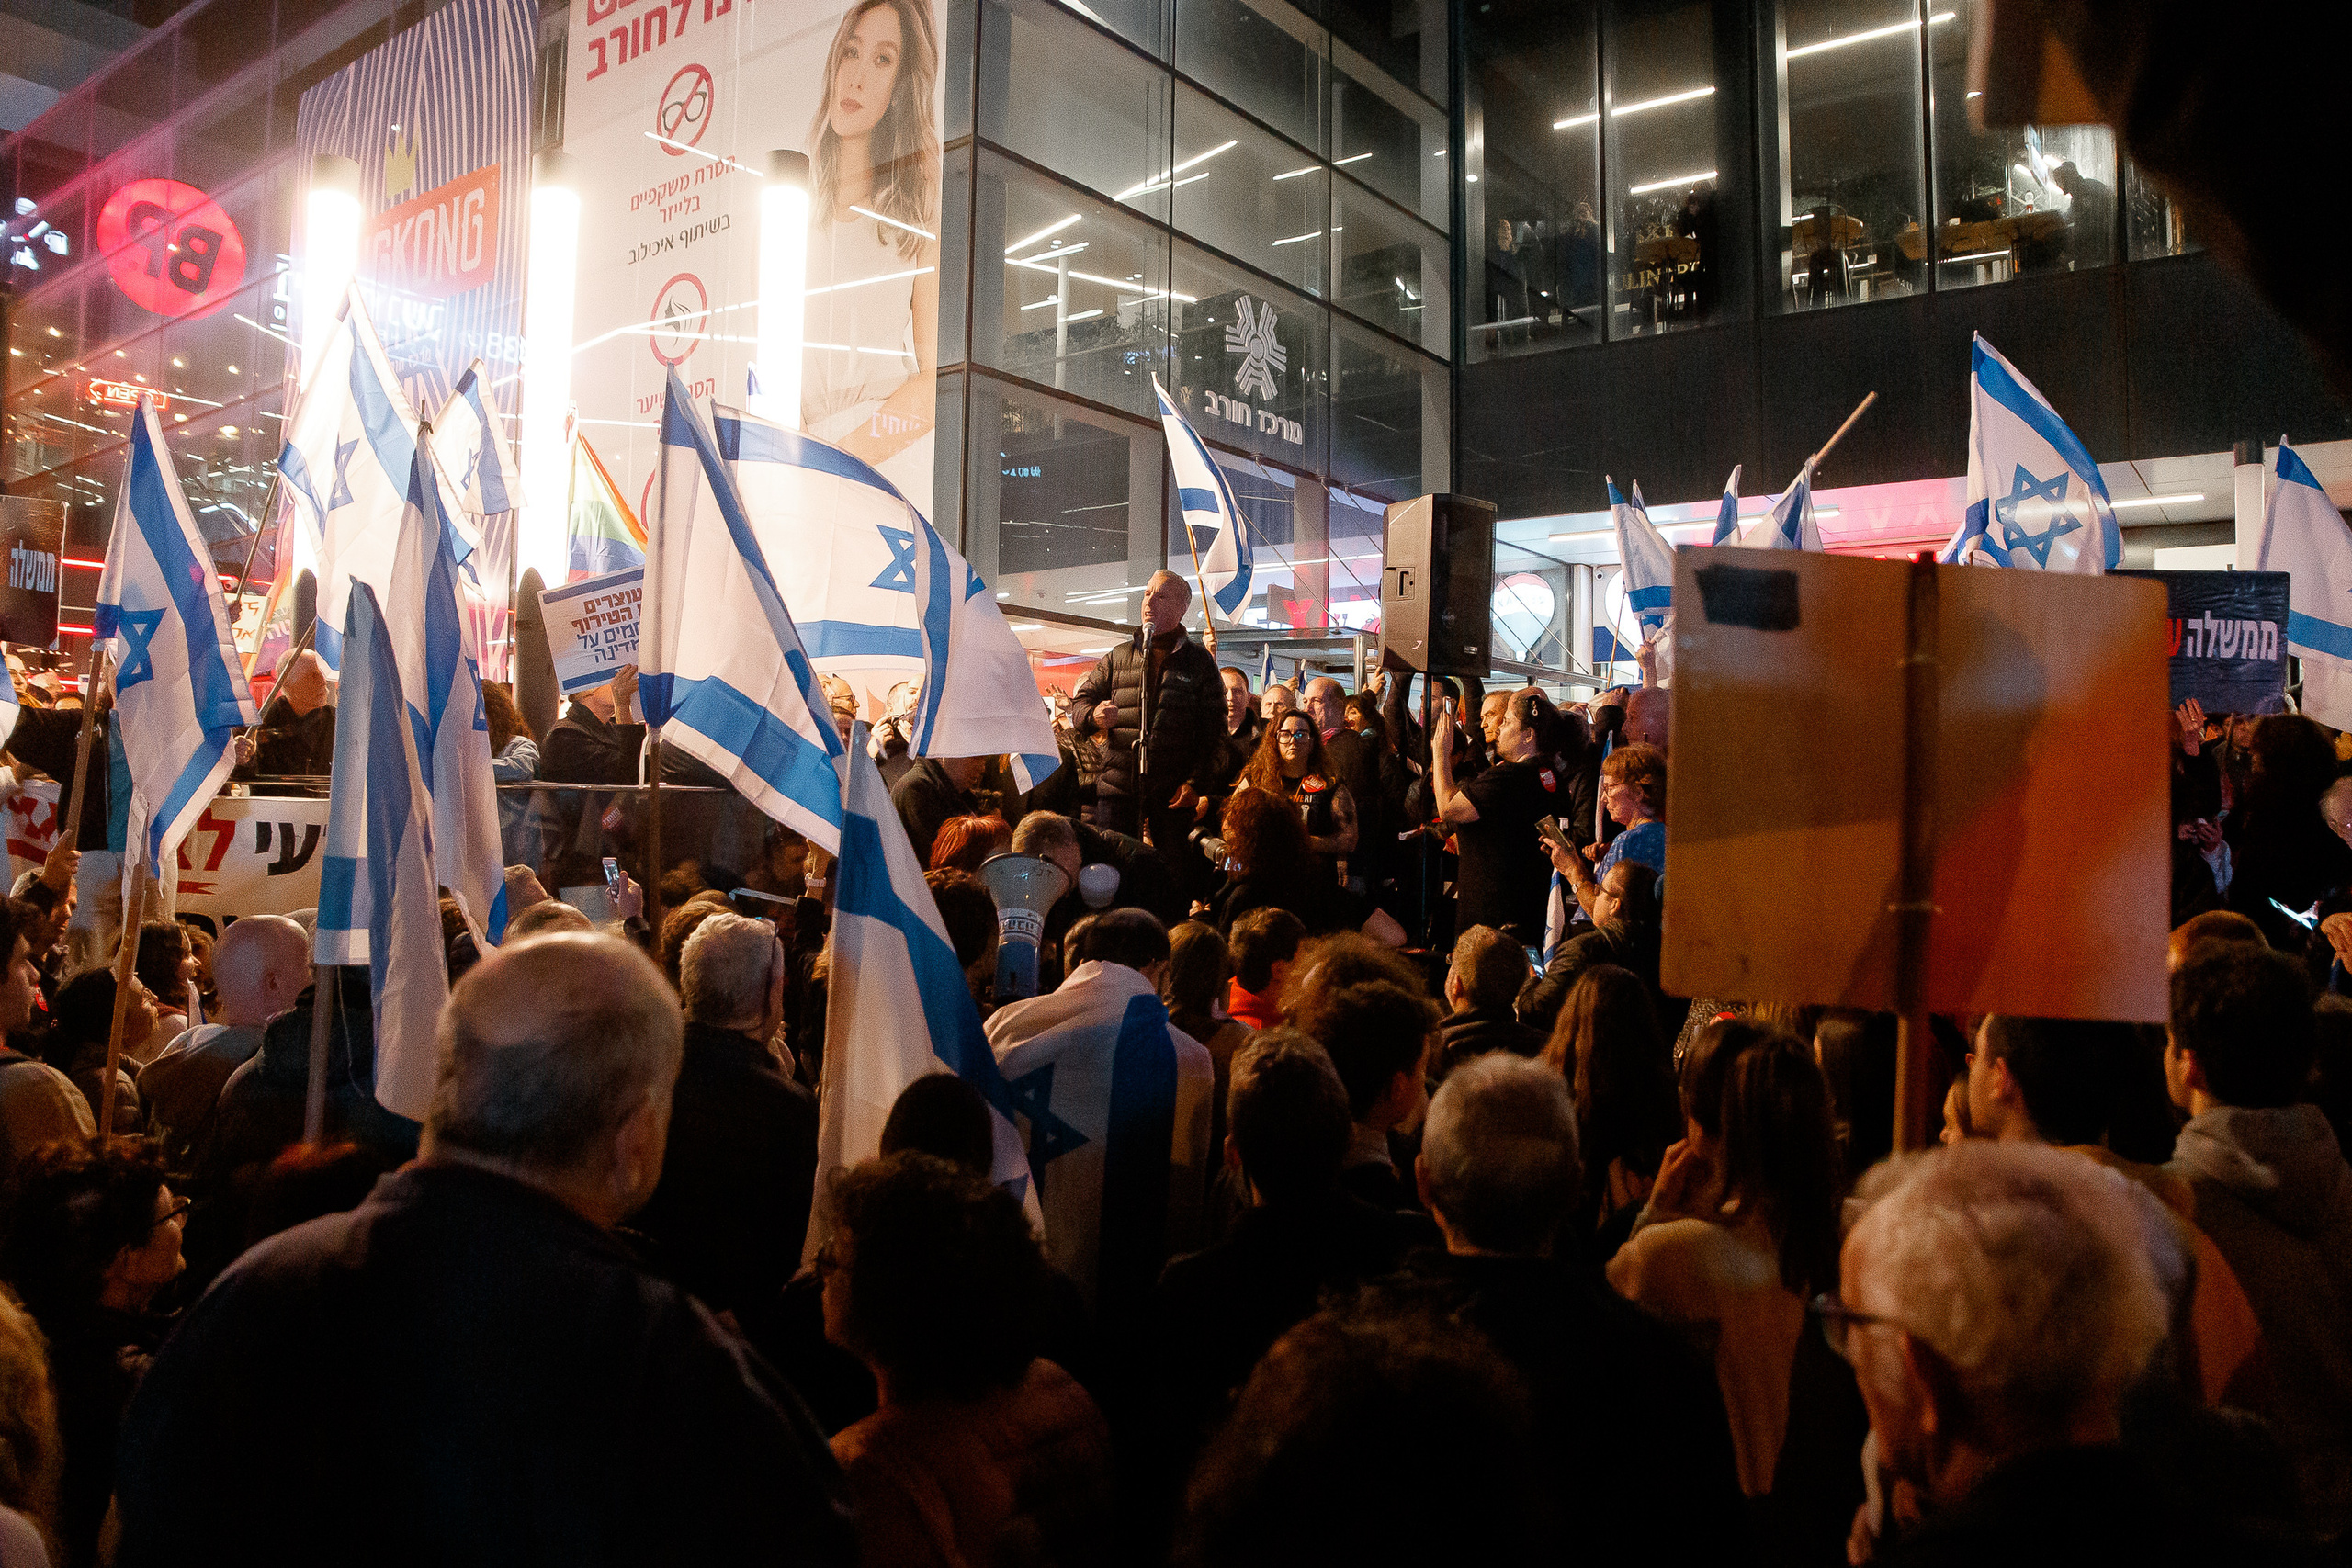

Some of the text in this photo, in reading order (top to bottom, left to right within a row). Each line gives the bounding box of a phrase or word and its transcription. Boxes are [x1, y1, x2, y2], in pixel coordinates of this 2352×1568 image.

[586, 0, 691, 82] לחורב
[630, 154, 736, 212] הסרת משקפיים
[659, 194, 701, 224] בלייזר
[628, 213, 731, 265] בשיתוף איכילוב
[1204, 389, 1303, 445] מרכז חורב
[9, 539, 56, 593] ממשלה
[571, 606, 633, 634] הטירוף
[577, 632, 599, 649] על
[2187, 610, 2278, 660] ממשלה
